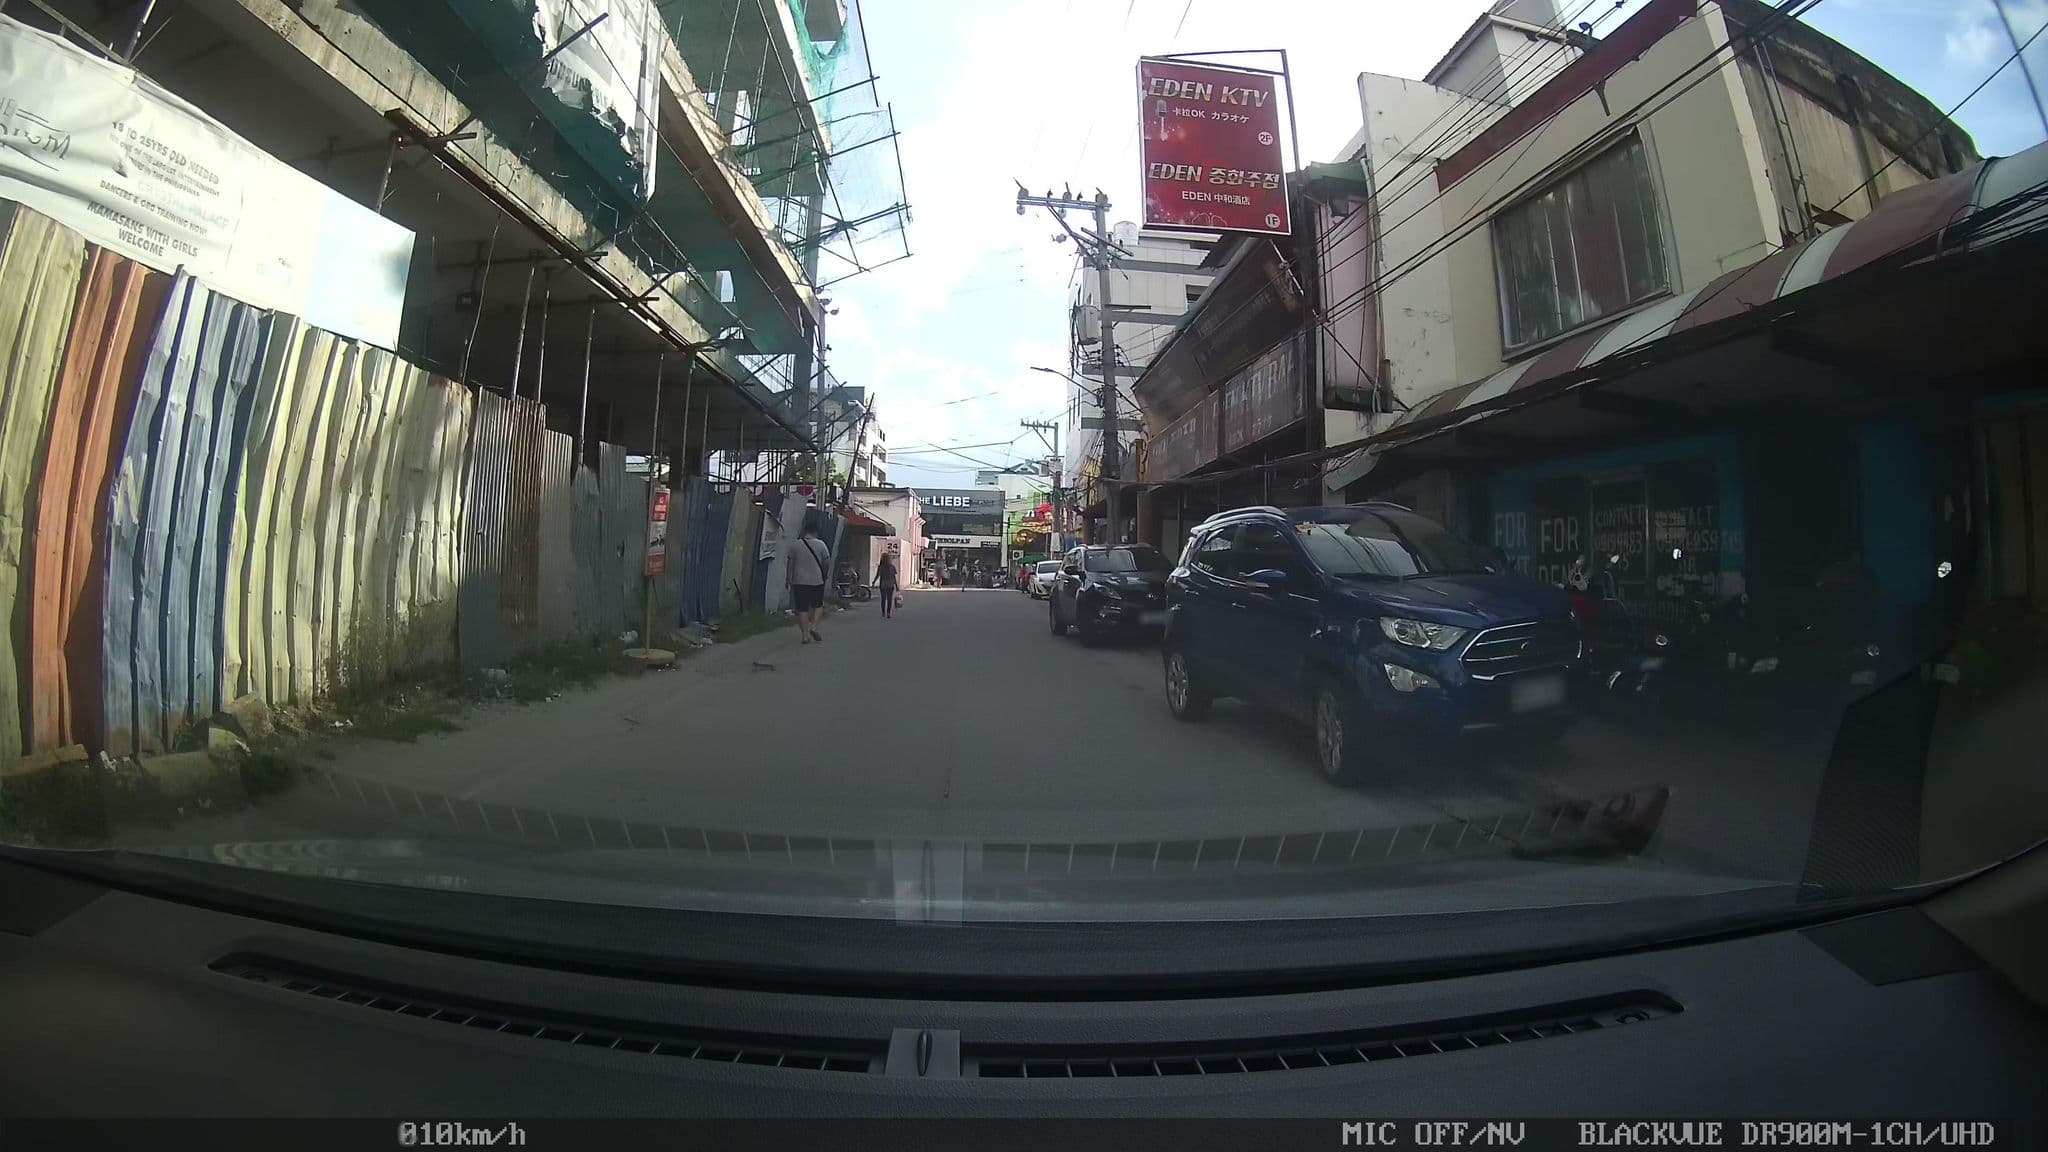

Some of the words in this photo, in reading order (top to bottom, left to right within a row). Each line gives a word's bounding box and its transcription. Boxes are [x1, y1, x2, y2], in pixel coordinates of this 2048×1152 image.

[1148, 77, 1213, 101] EDEN
[1220, 86, 1268, 108] KTV
[1211, 111, 1249, 124] カラオケ
[1259, 133, 1272, 144] 2F
[139, 135, 169, 156] 25YRS
[169, 150, 187, 166] OLD
[187, 154, 219, 185] NEEDED
[1148, 162, 1202, 182] EDEN
[100, 179, 132, 202] DANCERS
[1182, 190, 1212, 202] EDEN
[86, 200, 144, 235] MAMASANS
[146, 225, 170, 246] WITH
[171, 238, 199, 257] GIRLS
[118, 228, 165, 257] WELCOME
[932, 495, 971, 507] LIEBE
[1494, 511, 1527, 546] FOR
[1540, 516, 1579, 553] FOR
